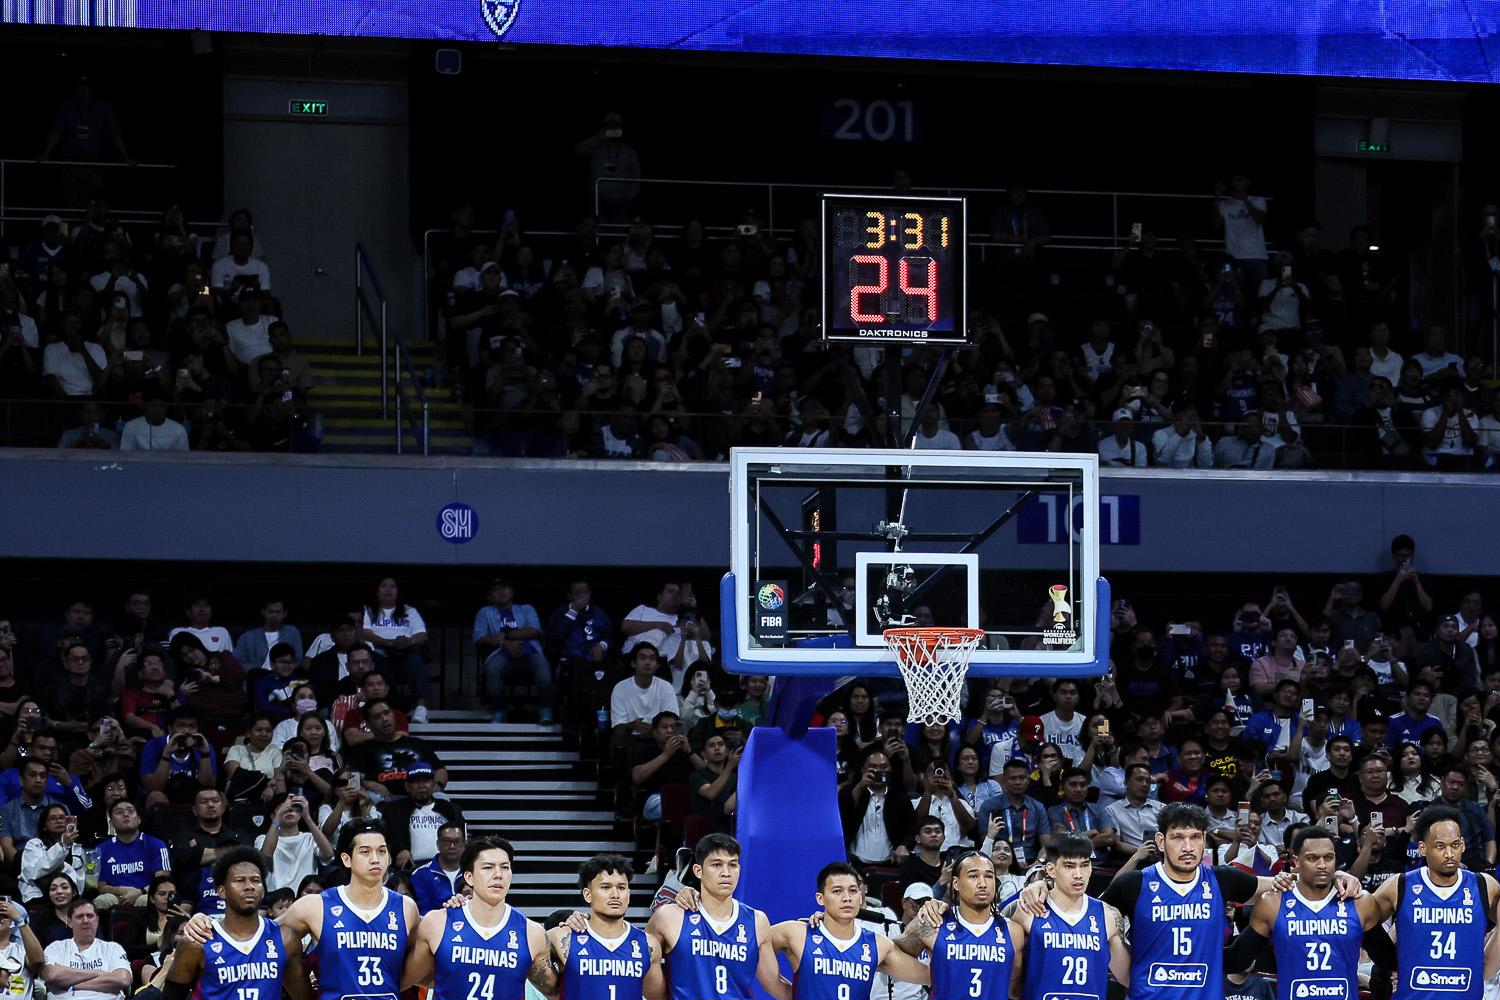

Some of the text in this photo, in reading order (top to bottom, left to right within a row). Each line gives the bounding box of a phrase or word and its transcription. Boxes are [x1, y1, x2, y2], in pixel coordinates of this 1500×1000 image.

[291, 102, 326, 113] EXIT
[835, 97, 914, 143] 201
[865, 211, 949, 249] 3:31
[850, 255, 936, 322] 24
[858, 329, 929, 339] DAKTRONICS
[760, 616, 783, 627] FIBA
[112, 861, 144, 875] PILIPINAS
[1151, 902, 1211, 922] PILIPINAS
[1413, 907, 1473, 924] PILIPINAS
[1287, 918, 1348, 936] PILIPINAS
[336, 931, 398, 951] PILIPINAS
[691, 937, 748, 962] PILIPINAS
[1043, 930, 1101, 952] PILIPINAS
[1171, 926, 1192, 956] 15
[1429, 930, 1457, 960] 34
[451, 944, 519, 969] PILIPINAS
[946, 943, 1006, 963] PILIPINAS
[1305, 942, 1332, 971] 32
[214, 962, 278, 984] PILIPINAS
[357, 955, 384, 986] 33
[579, 956, 643, 978] PILIPINAS
[814, 957, 872, 982] PILIPINAS
[1061, 955, 1088, 986] 28
[1167, 969, 1202, 982] Smart
[714, 965, 728, 995] 8
[969, 968, 983, 998] 3
[1308, 983, 1344, 997] Smart
[1430, 972, 1467, 986] Smart
